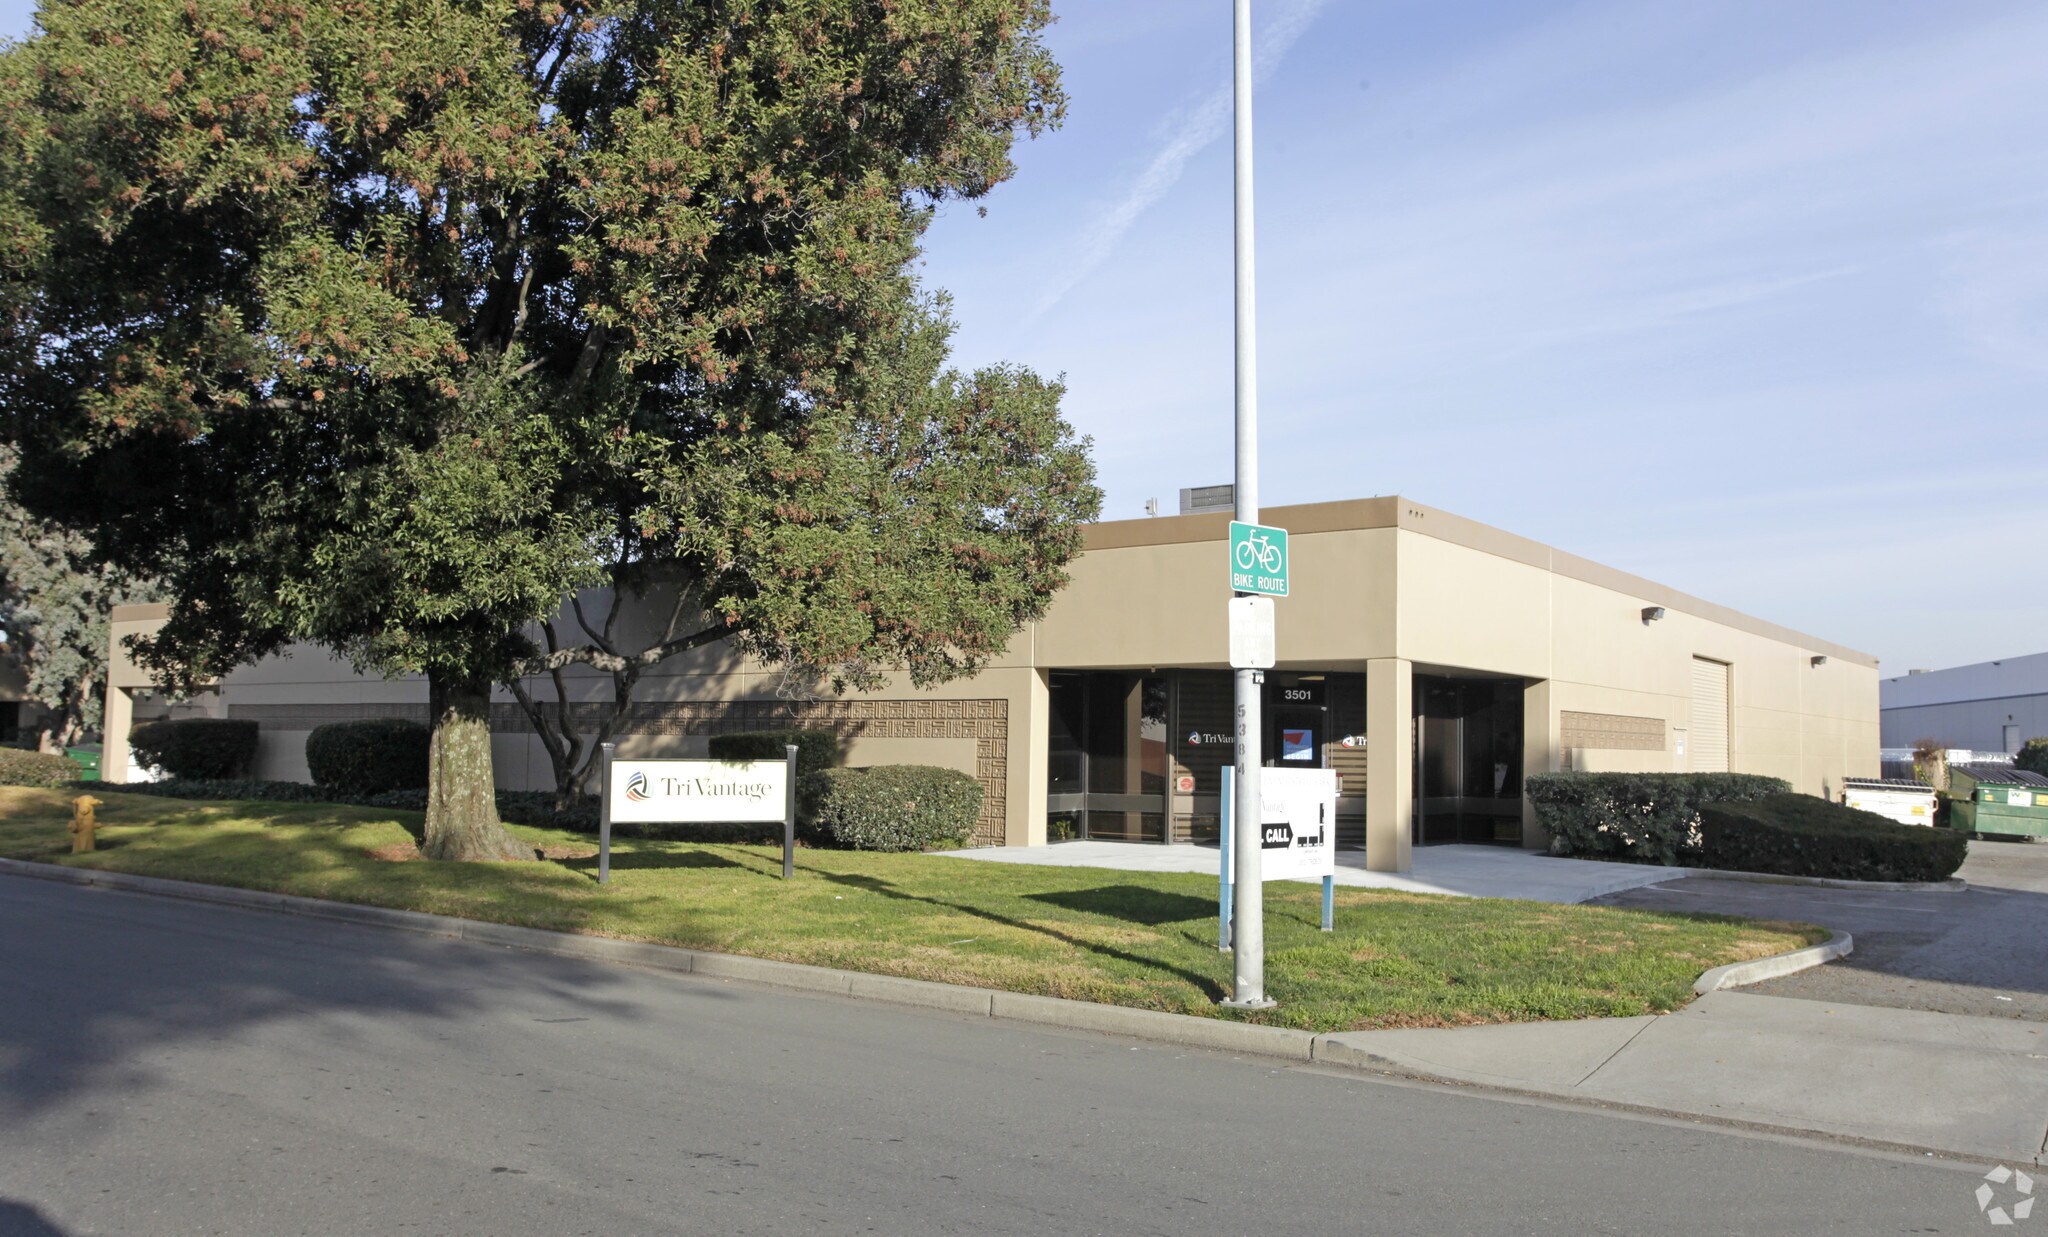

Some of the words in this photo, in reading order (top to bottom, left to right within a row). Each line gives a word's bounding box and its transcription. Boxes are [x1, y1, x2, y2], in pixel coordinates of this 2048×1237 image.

[1233, 572, 1254, 588] BIKE
[1257, 576, 1285, 592] ROUTE
[1284, 689, 1311, 700] 3501
[661, 777, 772, 803] TriVantage
[1265, 828, 1290, 843] CALL
